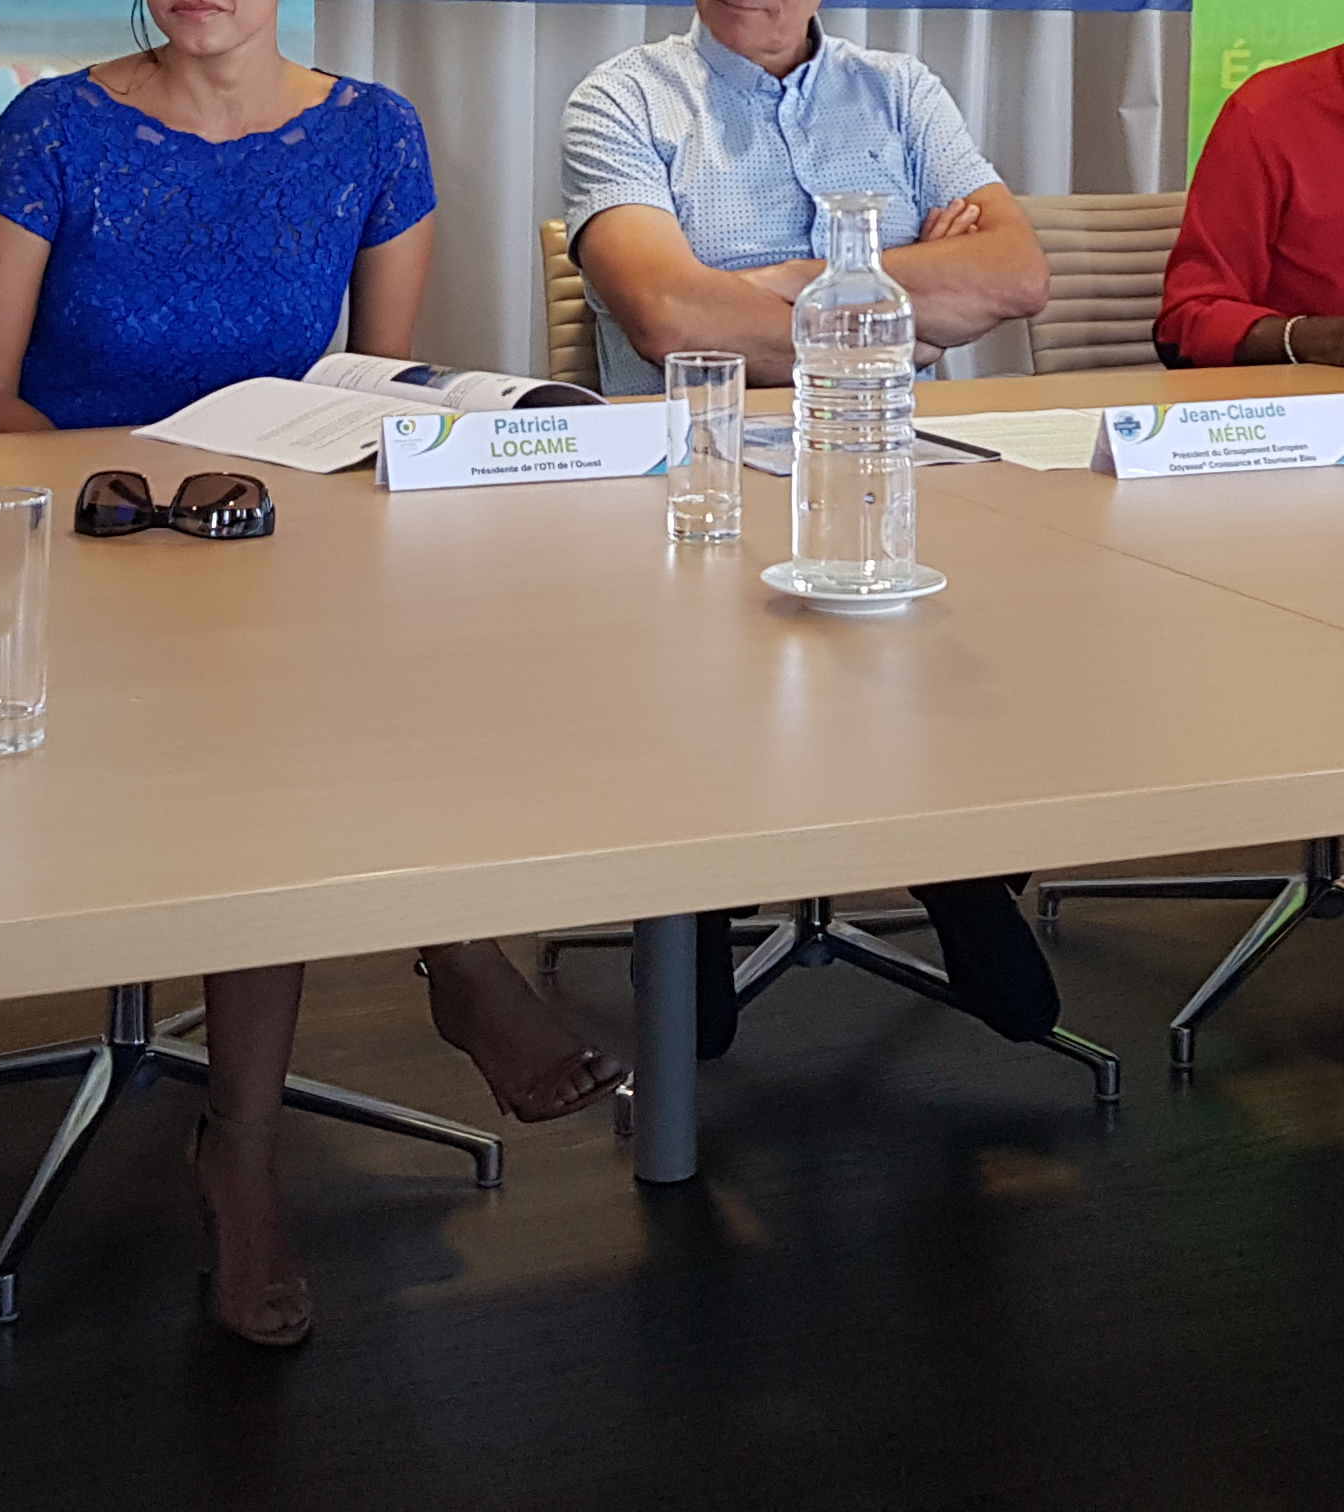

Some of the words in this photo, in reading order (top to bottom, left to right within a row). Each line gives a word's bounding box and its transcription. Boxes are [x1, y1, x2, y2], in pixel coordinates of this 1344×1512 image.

[1179, 401, 1286, 424] Jean-Claude
[494, 415, 569, 435] Patricia
[1208, 423, 1267, 444] MÉRIC
[490, 436, 578, 458] LOCAME
[521, 464, 532, 472] de
[557, 462, 568, 470] de
